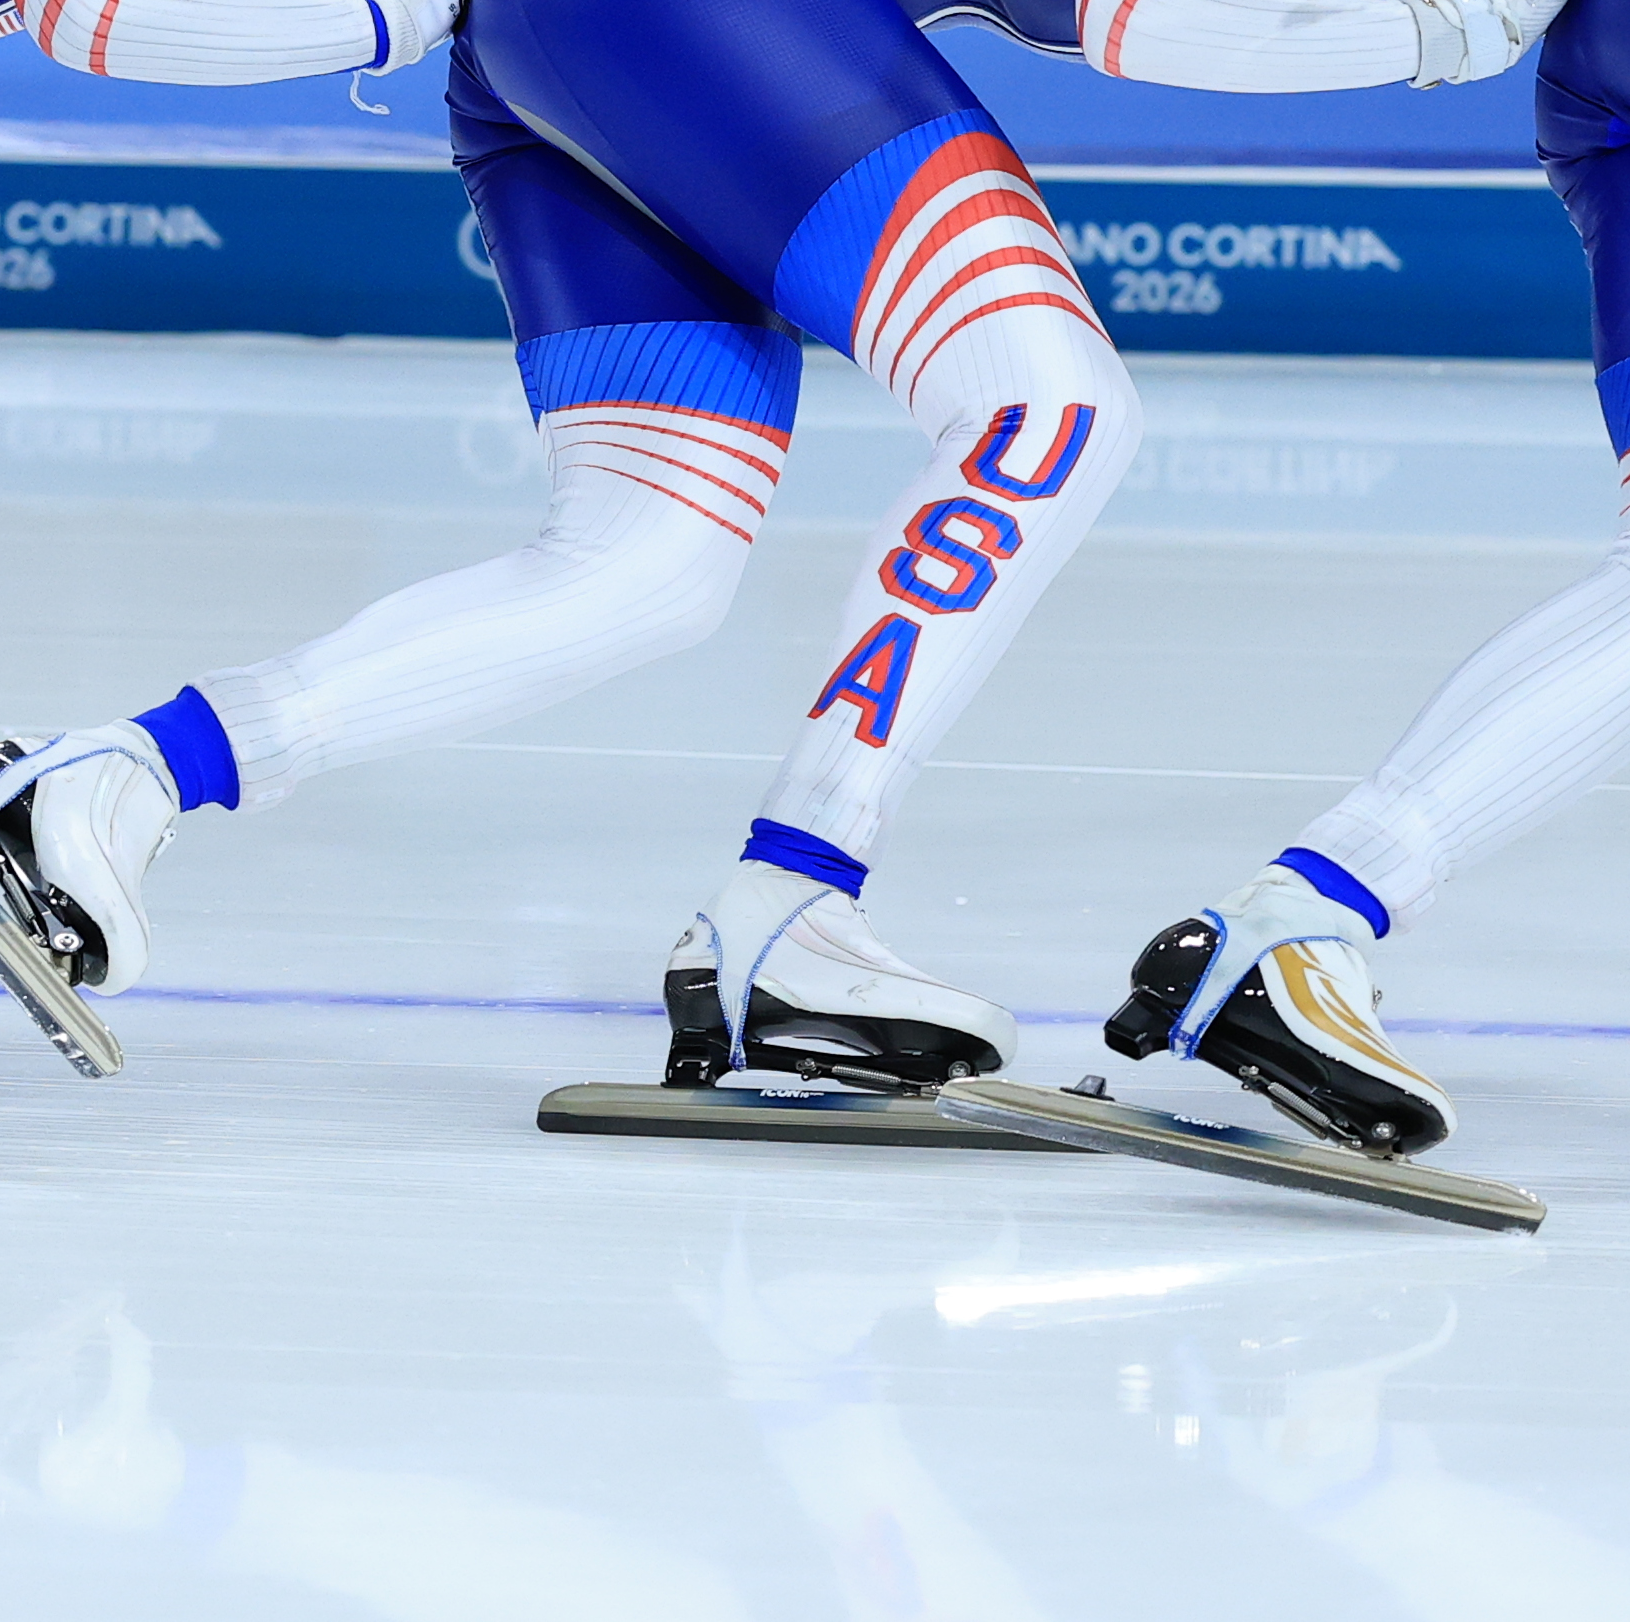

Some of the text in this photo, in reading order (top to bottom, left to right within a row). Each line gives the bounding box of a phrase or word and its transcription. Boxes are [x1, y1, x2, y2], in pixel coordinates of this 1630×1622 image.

[4, 199, 222, 249] CORTINA
[1166, 222, 1402, 273] CORTINA
[1110, 268, 1223, 316] 2026
[807, 402, 1097, 749] USA
[759, 1088, 800, 1098] ICON
